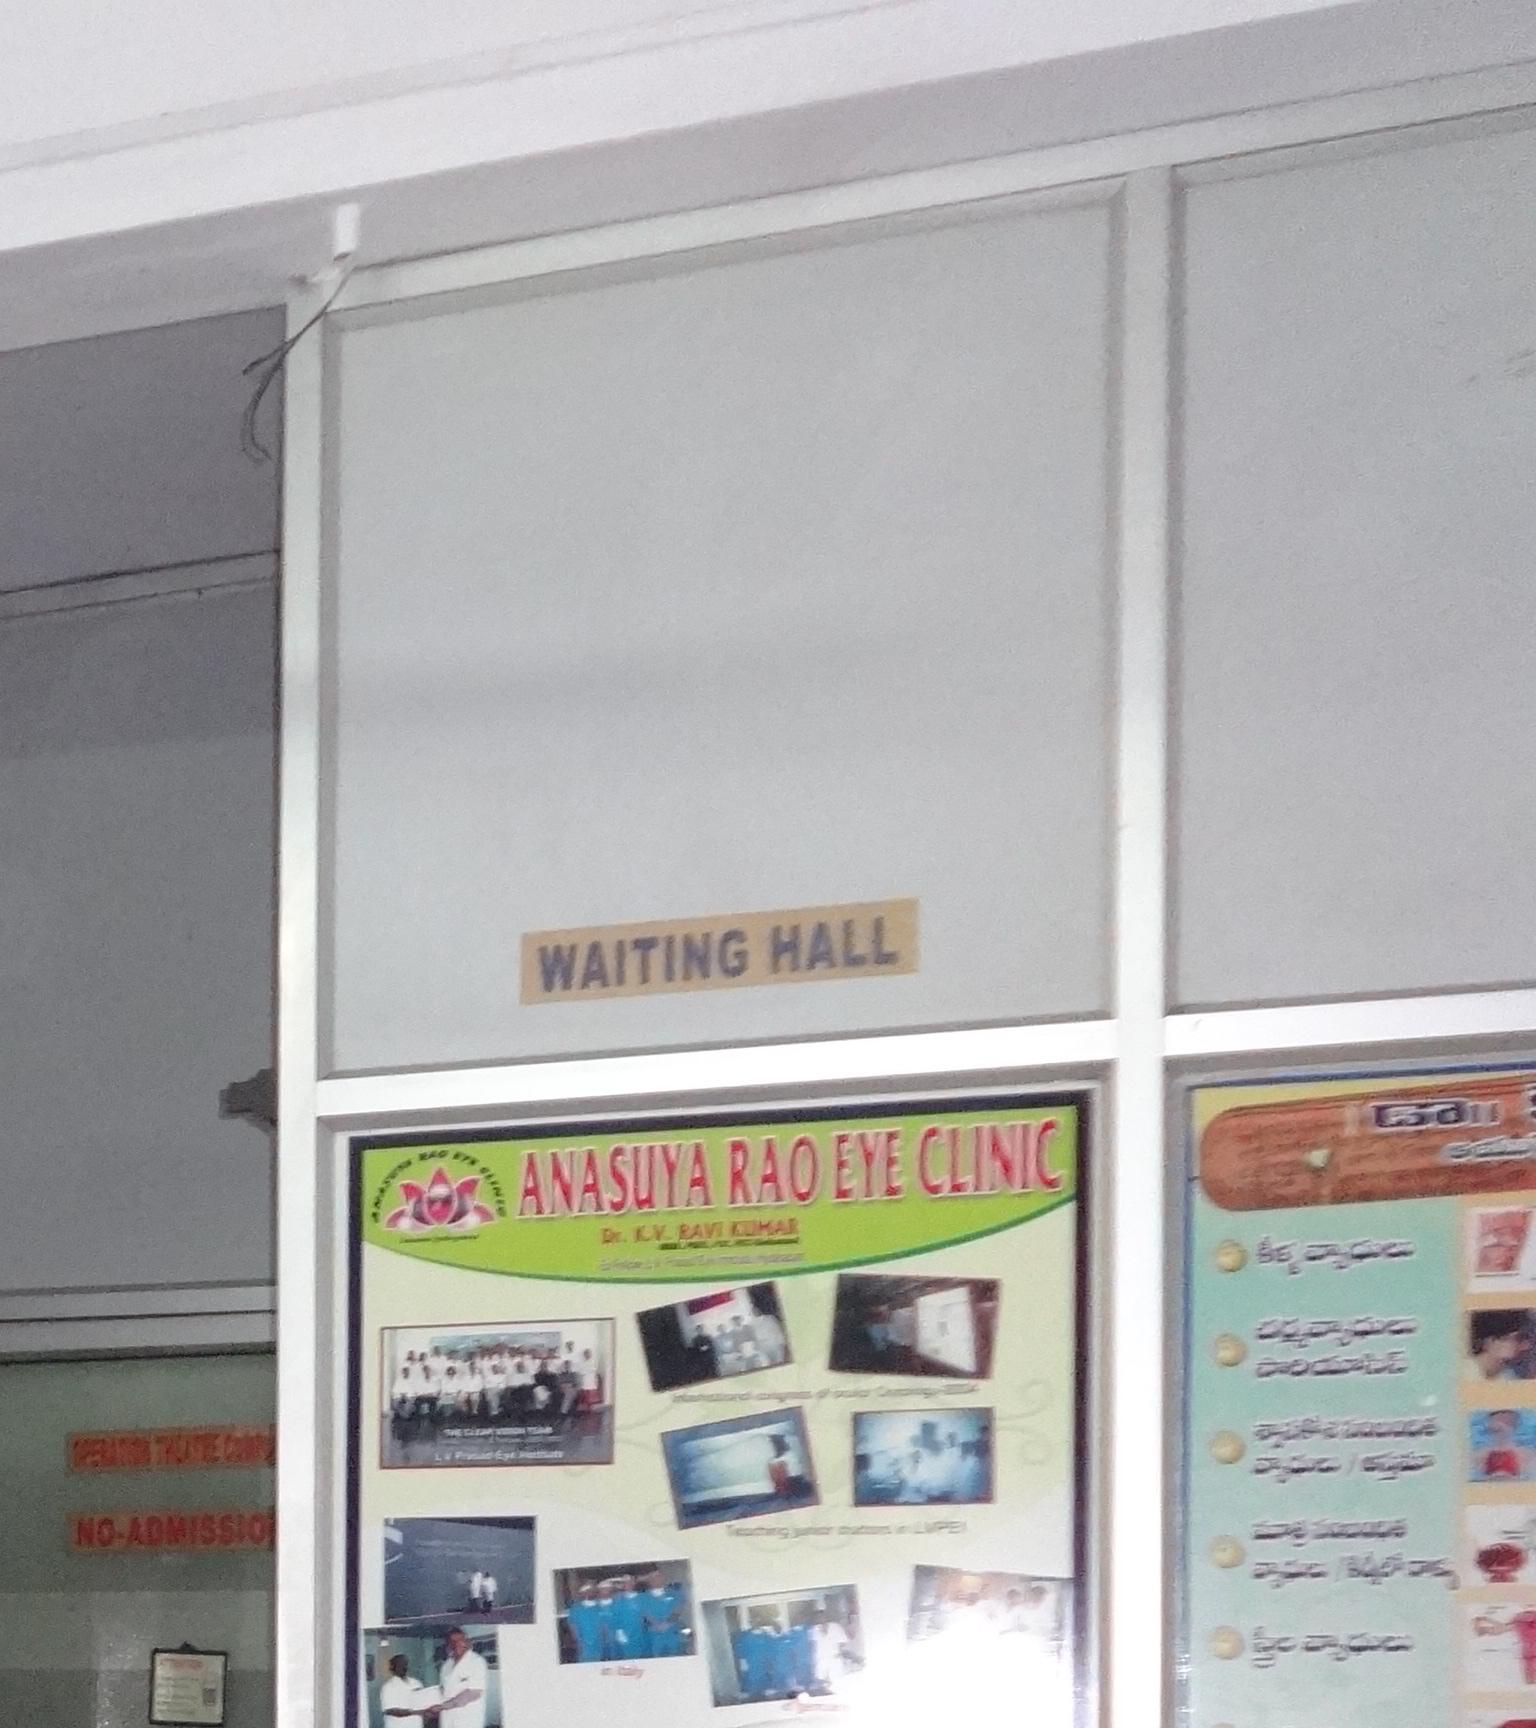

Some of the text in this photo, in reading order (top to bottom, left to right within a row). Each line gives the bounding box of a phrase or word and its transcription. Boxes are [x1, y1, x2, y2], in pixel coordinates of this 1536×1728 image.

[538, 917, 900, 993] WAITING HALL
[518, 1118, 1062, 1219] ANASUYA RAO EYE CLINIC
[77, 1512, 273, 1548] NO-ADMISSIO
